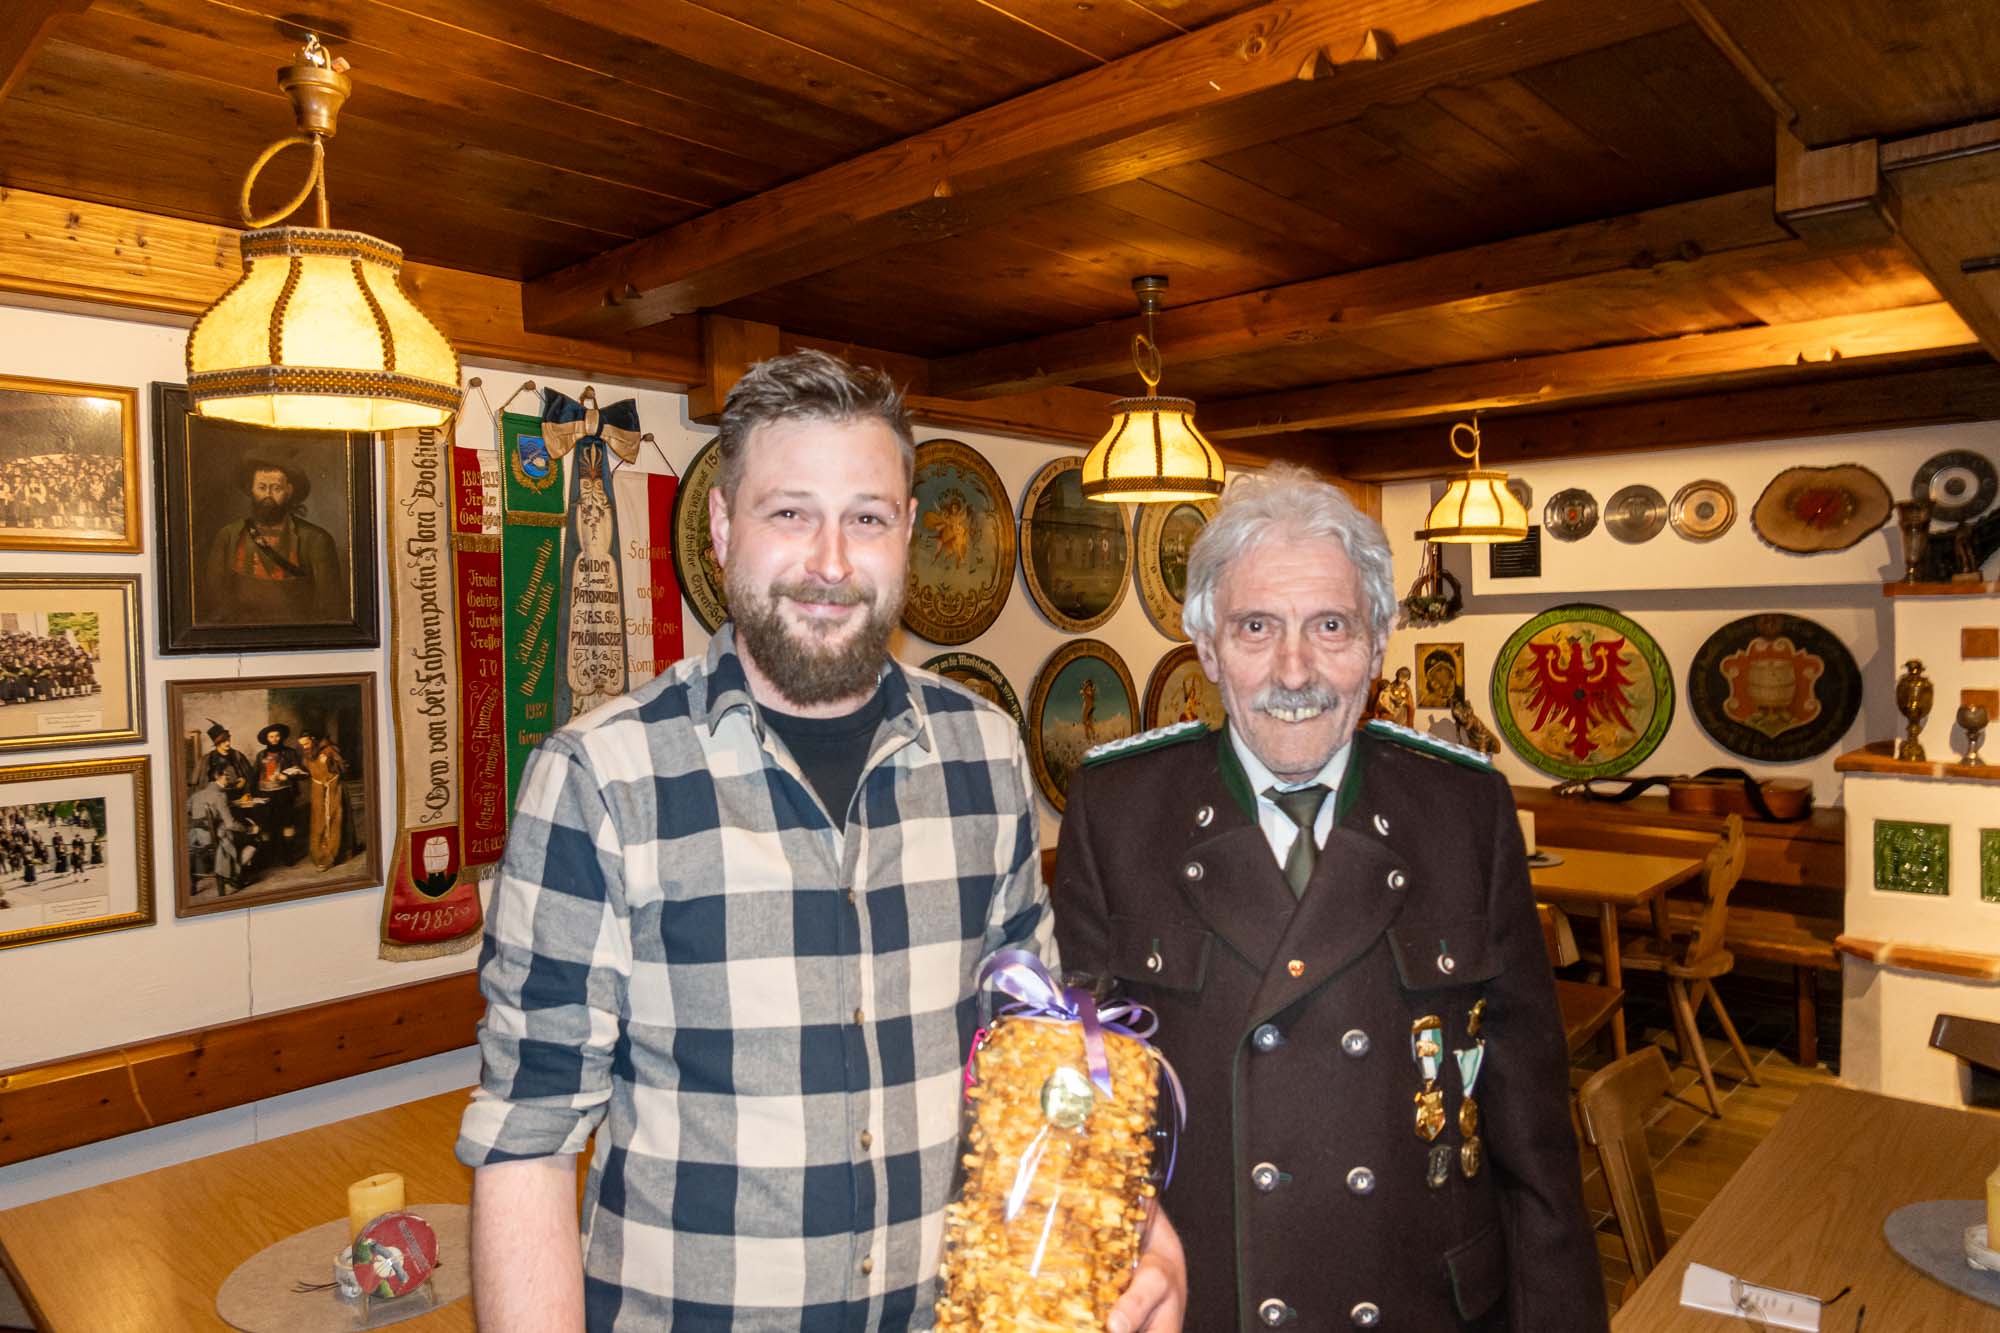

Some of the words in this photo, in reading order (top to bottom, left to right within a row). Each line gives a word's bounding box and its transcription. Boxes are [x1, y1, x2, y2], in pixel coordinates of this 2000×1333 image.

[407, 510, 438, 567] Flora
[468, 569, 498, 588] Tiroler
[411, 564, 447, 693] Fahnenpatin
[416, 688, 446, 717] der
[428, 719, 448, 754] von
[410, 906, 453, 931] 1985
